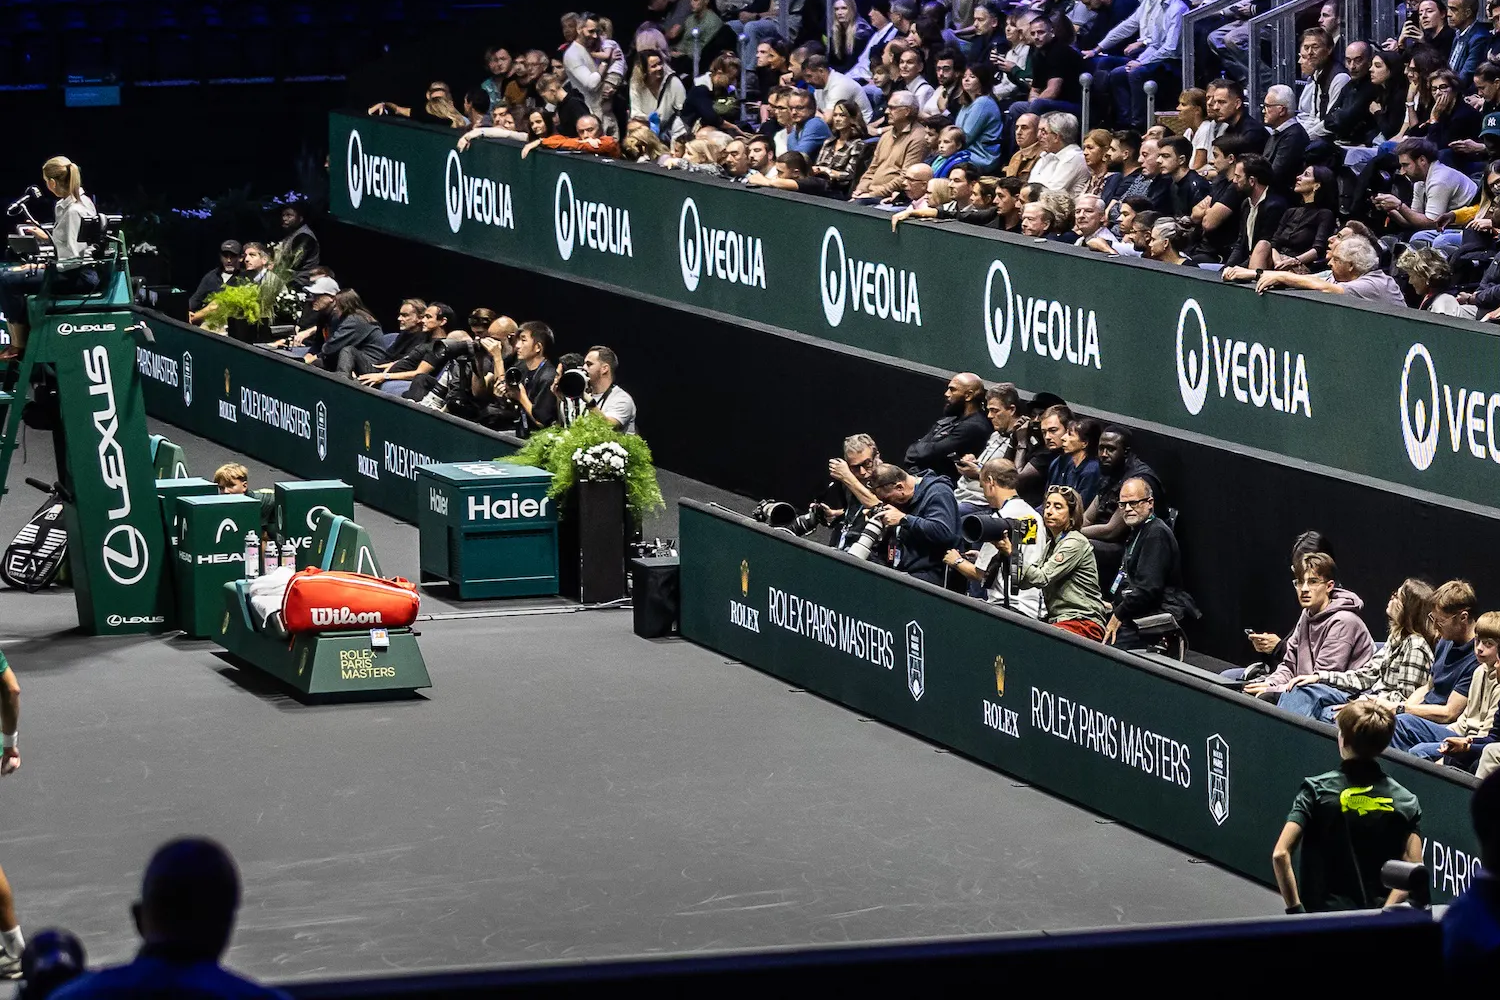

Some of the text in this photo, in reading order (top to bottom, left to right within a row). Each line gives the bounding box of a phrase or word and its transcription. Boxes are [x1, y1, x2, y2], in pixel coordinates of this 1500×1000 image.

[364, 154, 409, 205] VEOLIA
[464, 175, 515, 230] VEOLIA
[575, 200, 633, 258] VEOLIA
[702, 226, 767, 290] VEOLIA
[848, 257, 922, 327] VEOLIA
[73, 323, 116, 333] LEXUS
[1016, 293, 1102, 370] VEOLIA
[152, 352, 179, 387] MASTERS
[1212, 335, 1312, 419] VEOLIA
[83, 345, 131, 520] LEXUS
[241, 386, 262, 421] ROLEX
[261, 394, 280, 428] PARIS
[280, 401, 311, 440] MASTERS
[358, 454, 380, 480] ROLEX
[384, 440, 409, 479] ROLEX
[429, 487, 449, 516] Haier
[468, 492, 549, 520] Haier
[197, 552, 246, 565] HEA
[122, 615, 165, 624] LEXUS
[310, 606, 382, 625] Wilson
[729, 599, 761, 634] ROLEX
[768, 586, 805, 635] ROLEX
[805, 600, 837, 648] PARIS
[839, 613, 895, 670] MASTERS
[340, 649, 378, 661] ROLEX
[341, 659, 373, 670] PARIS
[342, 667, 396, 679] MASTERS
[982, 699, 1020, 739] ROLEX
[1031, 686, 1077, 744] ROLEX
[1079, 704, 1118, 760] PARIS
[1120, 720, 1191, 789] MASTERS
